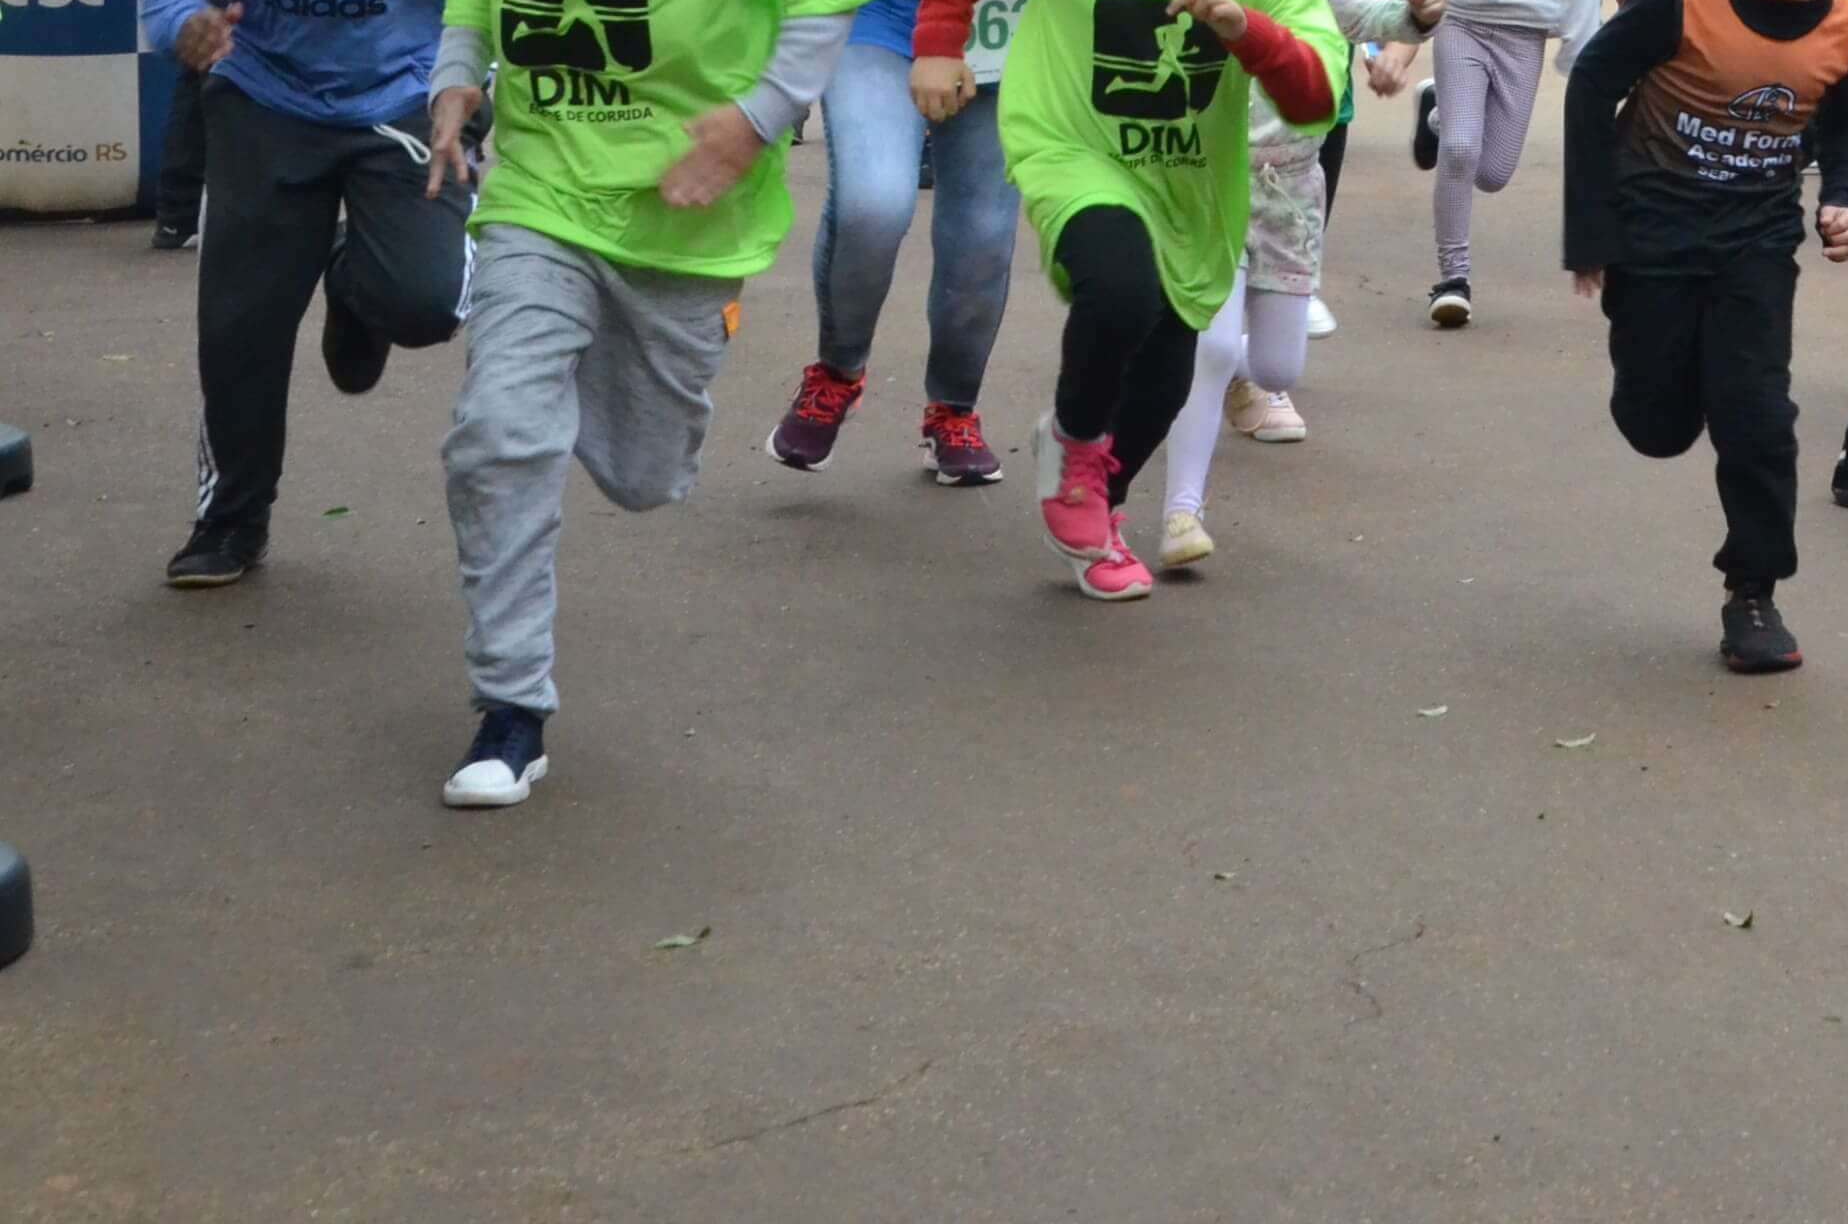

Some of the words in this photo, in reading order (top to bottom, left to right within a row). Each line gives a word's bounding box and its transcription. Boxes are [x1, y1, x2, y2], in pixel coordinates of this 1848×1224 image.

[529, 67, 632, 107] DIM
[587, 107, 654, 123] CORRIDA
[1676, 111, 1736, 147] Med
[0, 143, 88, 163] mércio
[95, 142, 128, 162] RS
[1119, 122, 1202, 156] DIM
